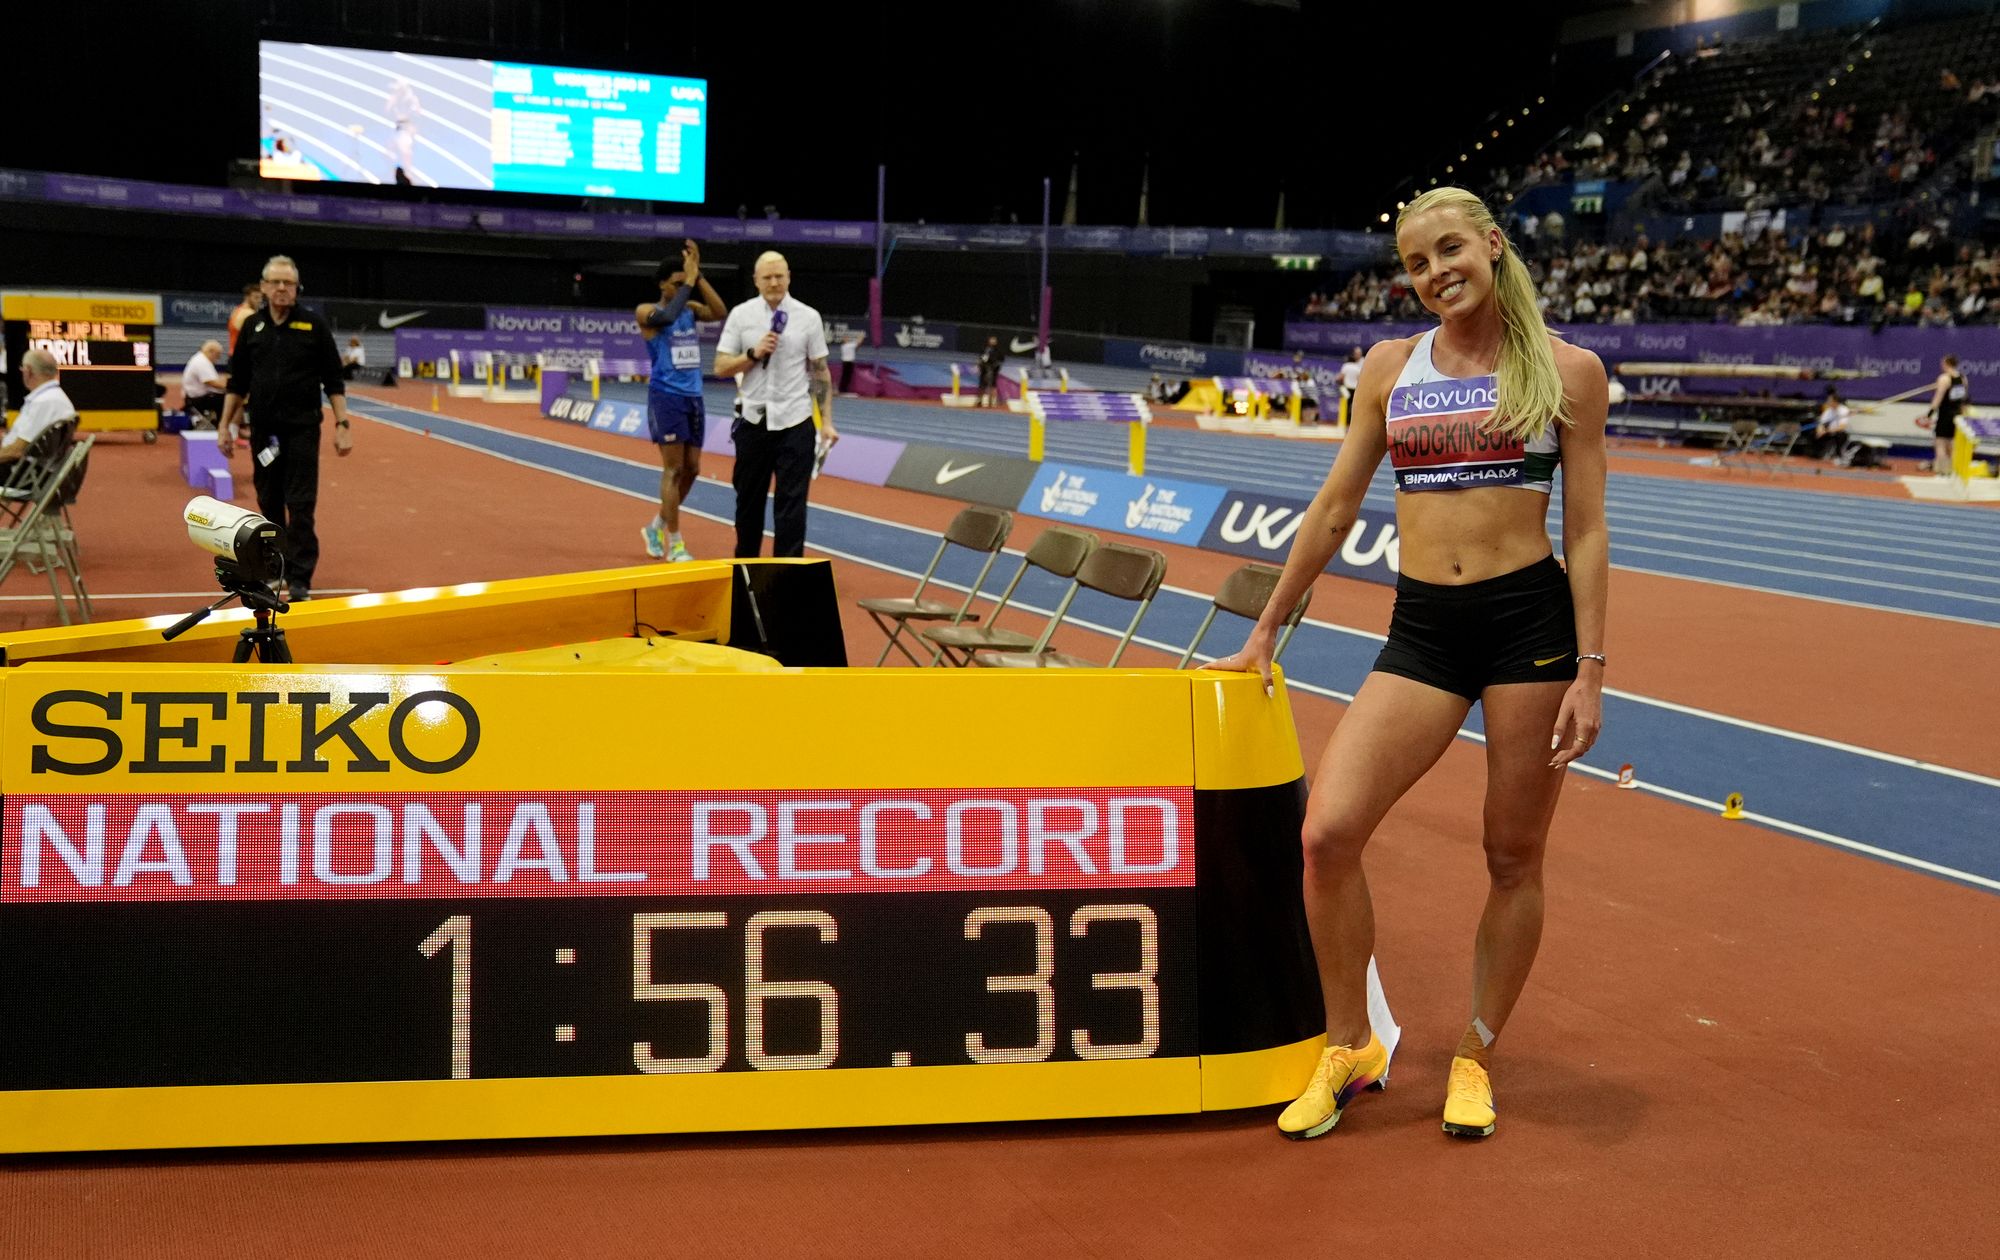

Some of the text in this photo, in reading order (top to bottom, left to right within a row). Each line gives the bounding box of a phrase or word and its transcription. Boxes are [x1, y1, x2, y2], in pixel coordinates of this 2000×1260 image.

[490, 313, 561, 332] Novuna
[1404, 468, 1518, 485] BIRMINGHAM
[30, 689, 481, 775] SEIKO
[18, 796, 1181, 888] NATIONAL RECORD
